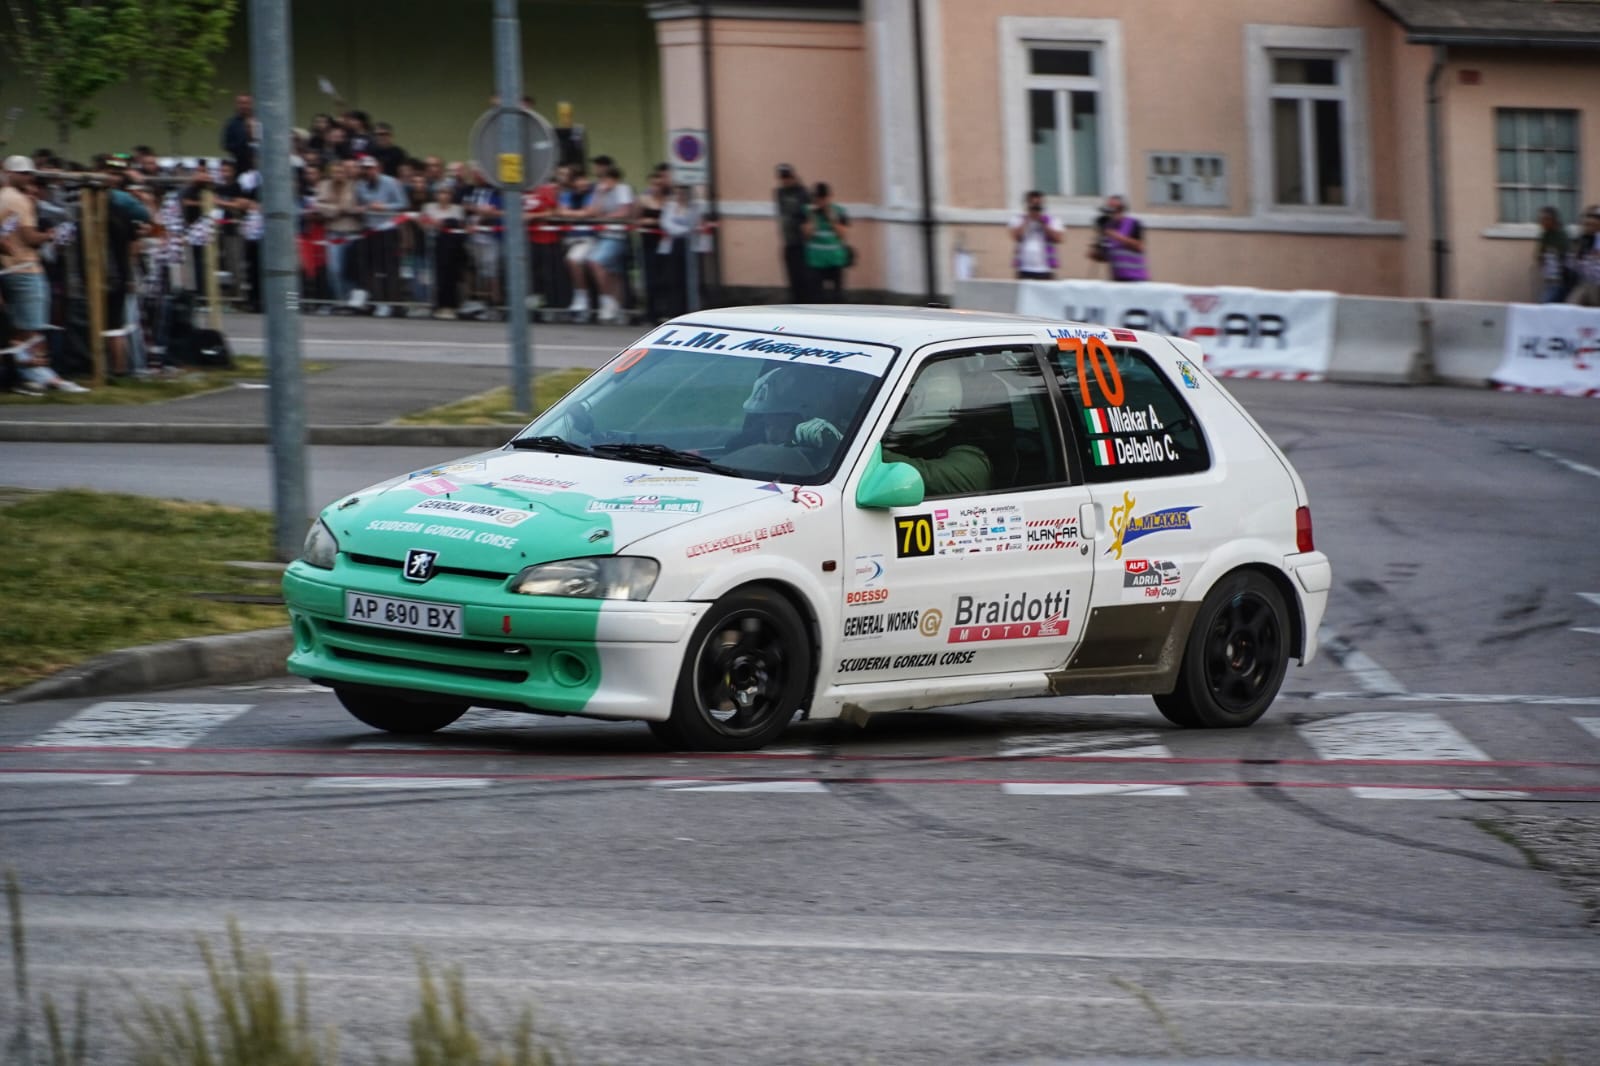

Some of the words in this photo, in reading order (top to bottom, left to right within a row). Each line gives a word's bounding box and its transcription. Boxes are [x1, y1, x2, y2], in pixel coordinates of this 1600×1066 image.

[653, 330, 728, 350] L.M.
[729, 338, 872, 364] Motorsport
[1056, 336, 1124, 407] 70
[1107, 406, 1149, 432] Mlakar
[1148, 404, 1164, 430] A.
[1114, 435, 1164, 464] Delbello
[1163, 434, 1180, 461] C.
[417, 500, 463, 512] GENERAL
[463, 503, 505, 516] WORKS
[1142, 511, 1188, 529] MLAKAR
[365, 519, 425, 533] SCUDERIA
[424, 524, 476, 541] GORIZIA
[475, 531, 519, 549] CORSE
[898, 518, 931, 554] 70
[1129, 561, 1146, 570] ALPE
[1132, 574, 1160, 586] ADRIA
[1145, 587, 1161, 599] Rally
[1161, 587, 1177, 598] Cup
[847, 588, 889, 604] BOESSO
[955, 589, 1071, 626] Braidotti
[352, 597, 379, 619] AP
[384, 602, 419, 626] 690
[427, 607, 456, 631] BX
[843, 614, 884, 637] GENERAL
[887, 610, 920, 632] WORKS
[838, 655, 889, 672] SCUDERIA
[893, 653, 939, 669] GORIZIA
[940, 650, 977, 665] CORSE
